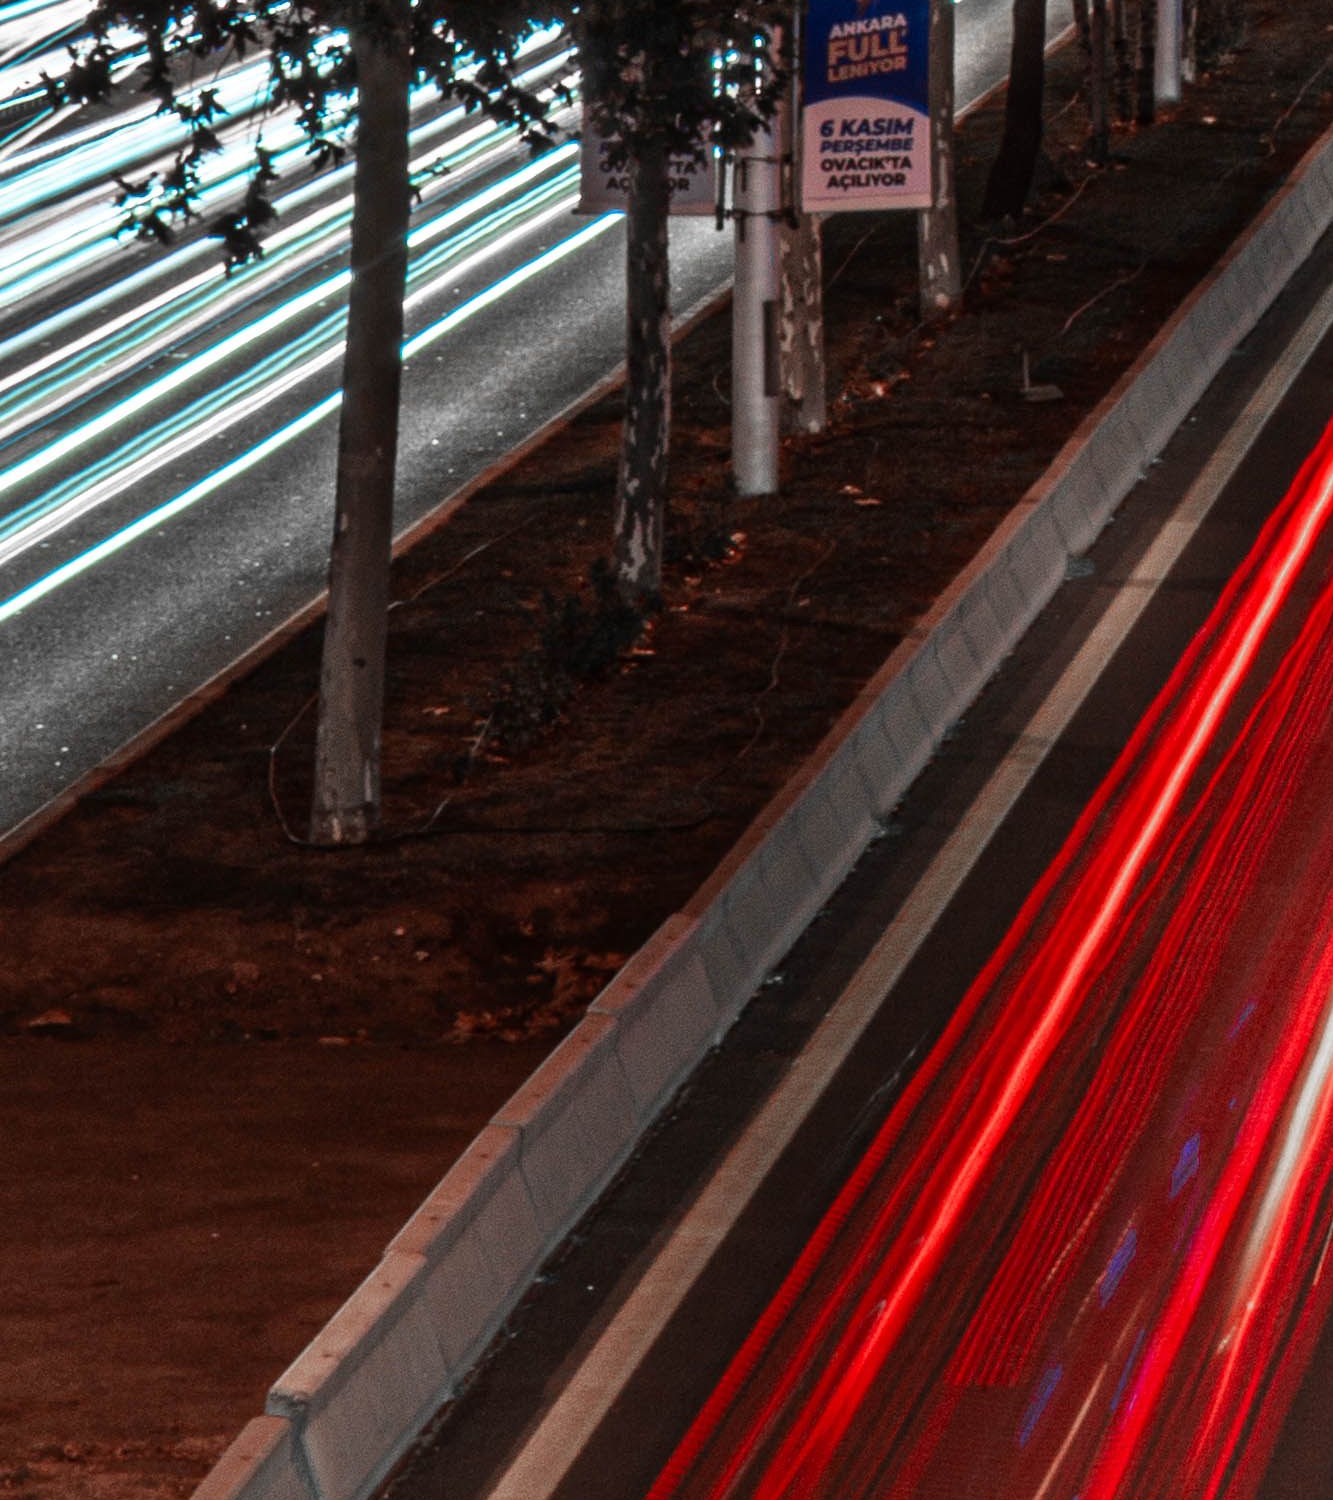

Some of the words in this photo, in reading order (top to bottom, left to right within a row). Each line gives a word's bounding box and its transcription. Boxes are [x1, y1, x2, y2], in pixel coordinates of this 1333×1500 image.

[829, 12, 907, 40] ANKARA
[820, 119, 835, 138] 6
[840, 117, 915, 137] KASIM
[819, 137, 914, 156] PERŞEMBE
[820, 155, 913, 172] OVACIK'TA
[827, 172, 907, 192] AÇILIYOR
